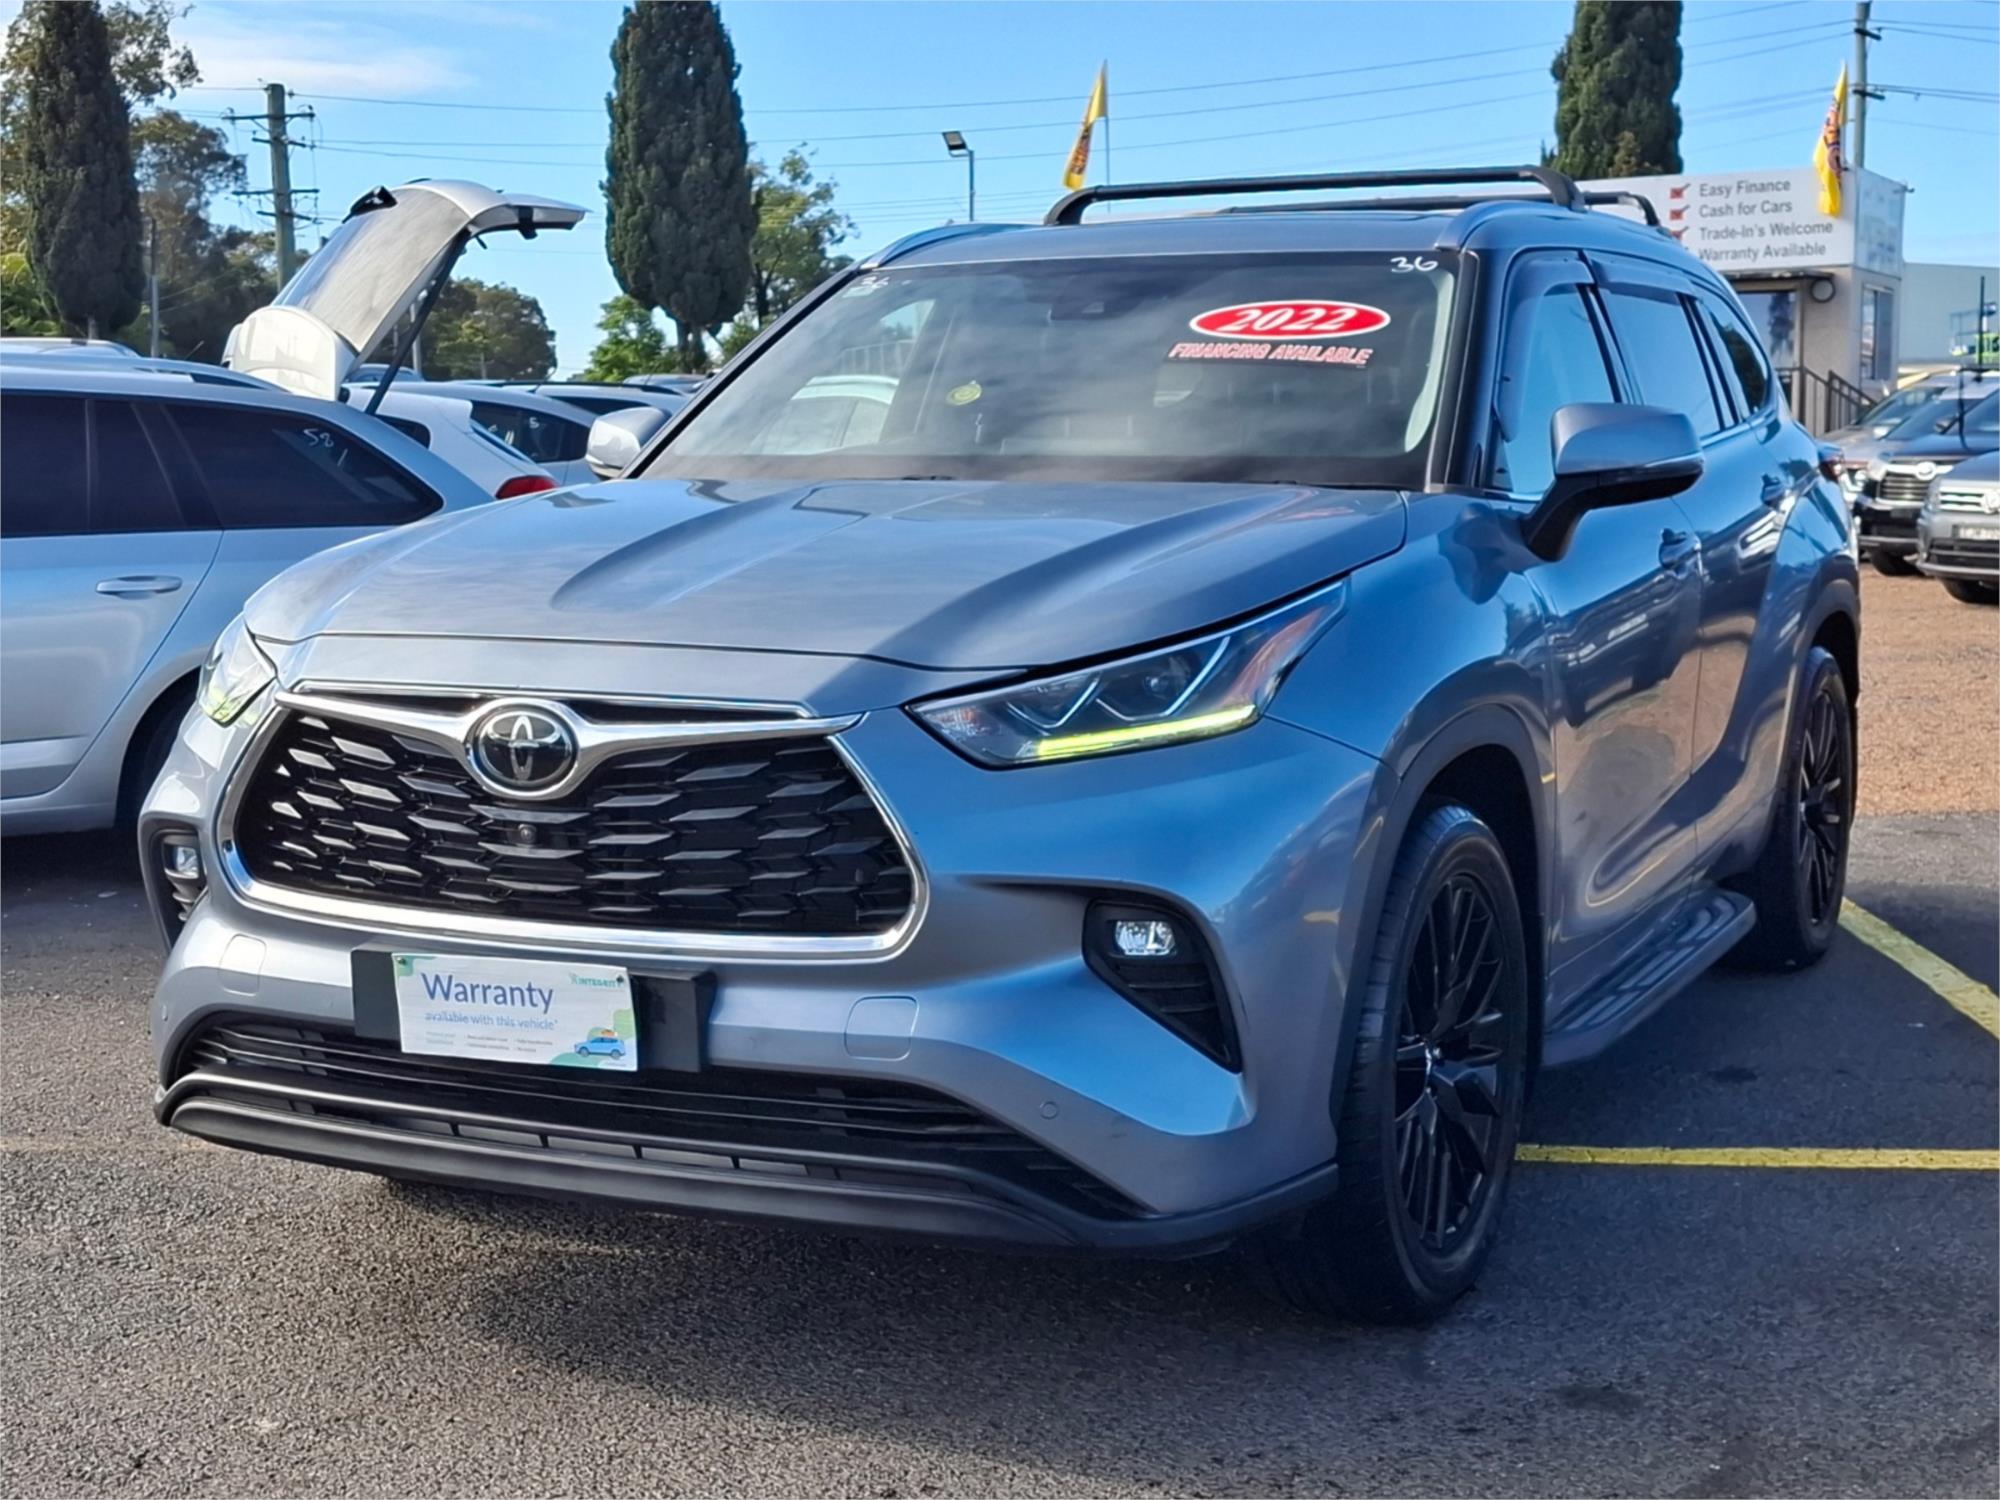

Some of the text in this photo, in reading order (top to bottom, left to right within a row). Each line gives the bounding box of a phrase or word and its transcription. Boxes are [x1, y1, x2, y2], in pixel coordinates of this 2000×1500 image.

[1699, 180, 1792, 199] Easy Finance
[1699, 200, 1793, 218] Cash for Cars
[1699, 222, 1834, 240] Trade-In's Welcome
[1698, 242, 1827, 262] Warranty Available
[1390, 256, 1439, 273] 36
[1216, 308, 1357, 332] 2022
[1168, 342, 1373, 364] FINANCING AVAILABLE
[420, 972, 554, 1015] Warranty
[425, 1012, 470, 1024] available
[470, 1014, 495, 1026] with
[496, 1015, 517, 1028] this
